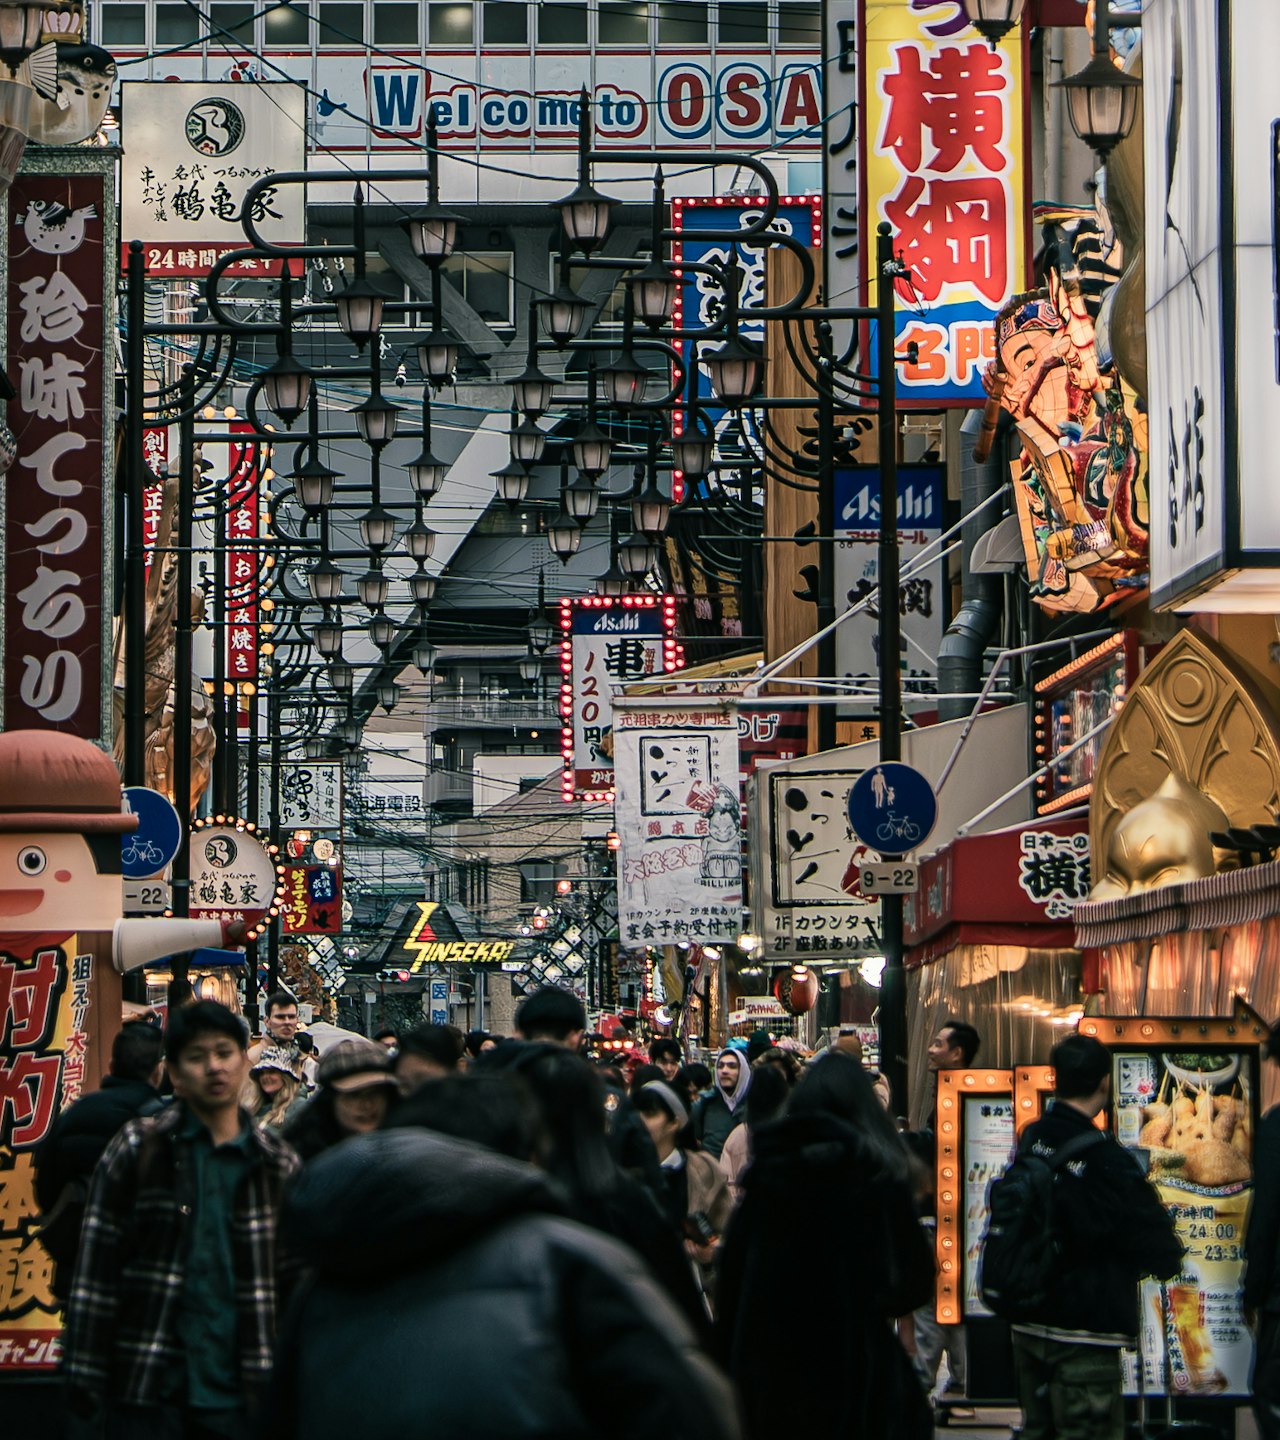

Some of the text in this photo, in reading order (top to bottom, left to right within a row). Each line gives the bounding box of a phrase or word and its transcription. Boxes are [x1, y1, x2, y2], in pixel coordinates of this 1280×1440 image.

[598, 91, 638, 128] to
[880, 42, 1010, 305] 横綱
[170, 180, 285, 223] 鶴亀家
[841, 484, 933, 521] Ashi
[845, 530, 929, 545] アサール
[592, 611, 640, 632] Asahi
[618, 712, 732, 729] 元祖串カツ専門店
[1023, 835, 1088, 850] 日本一の
[863, 868, 915, 887] 9-22
